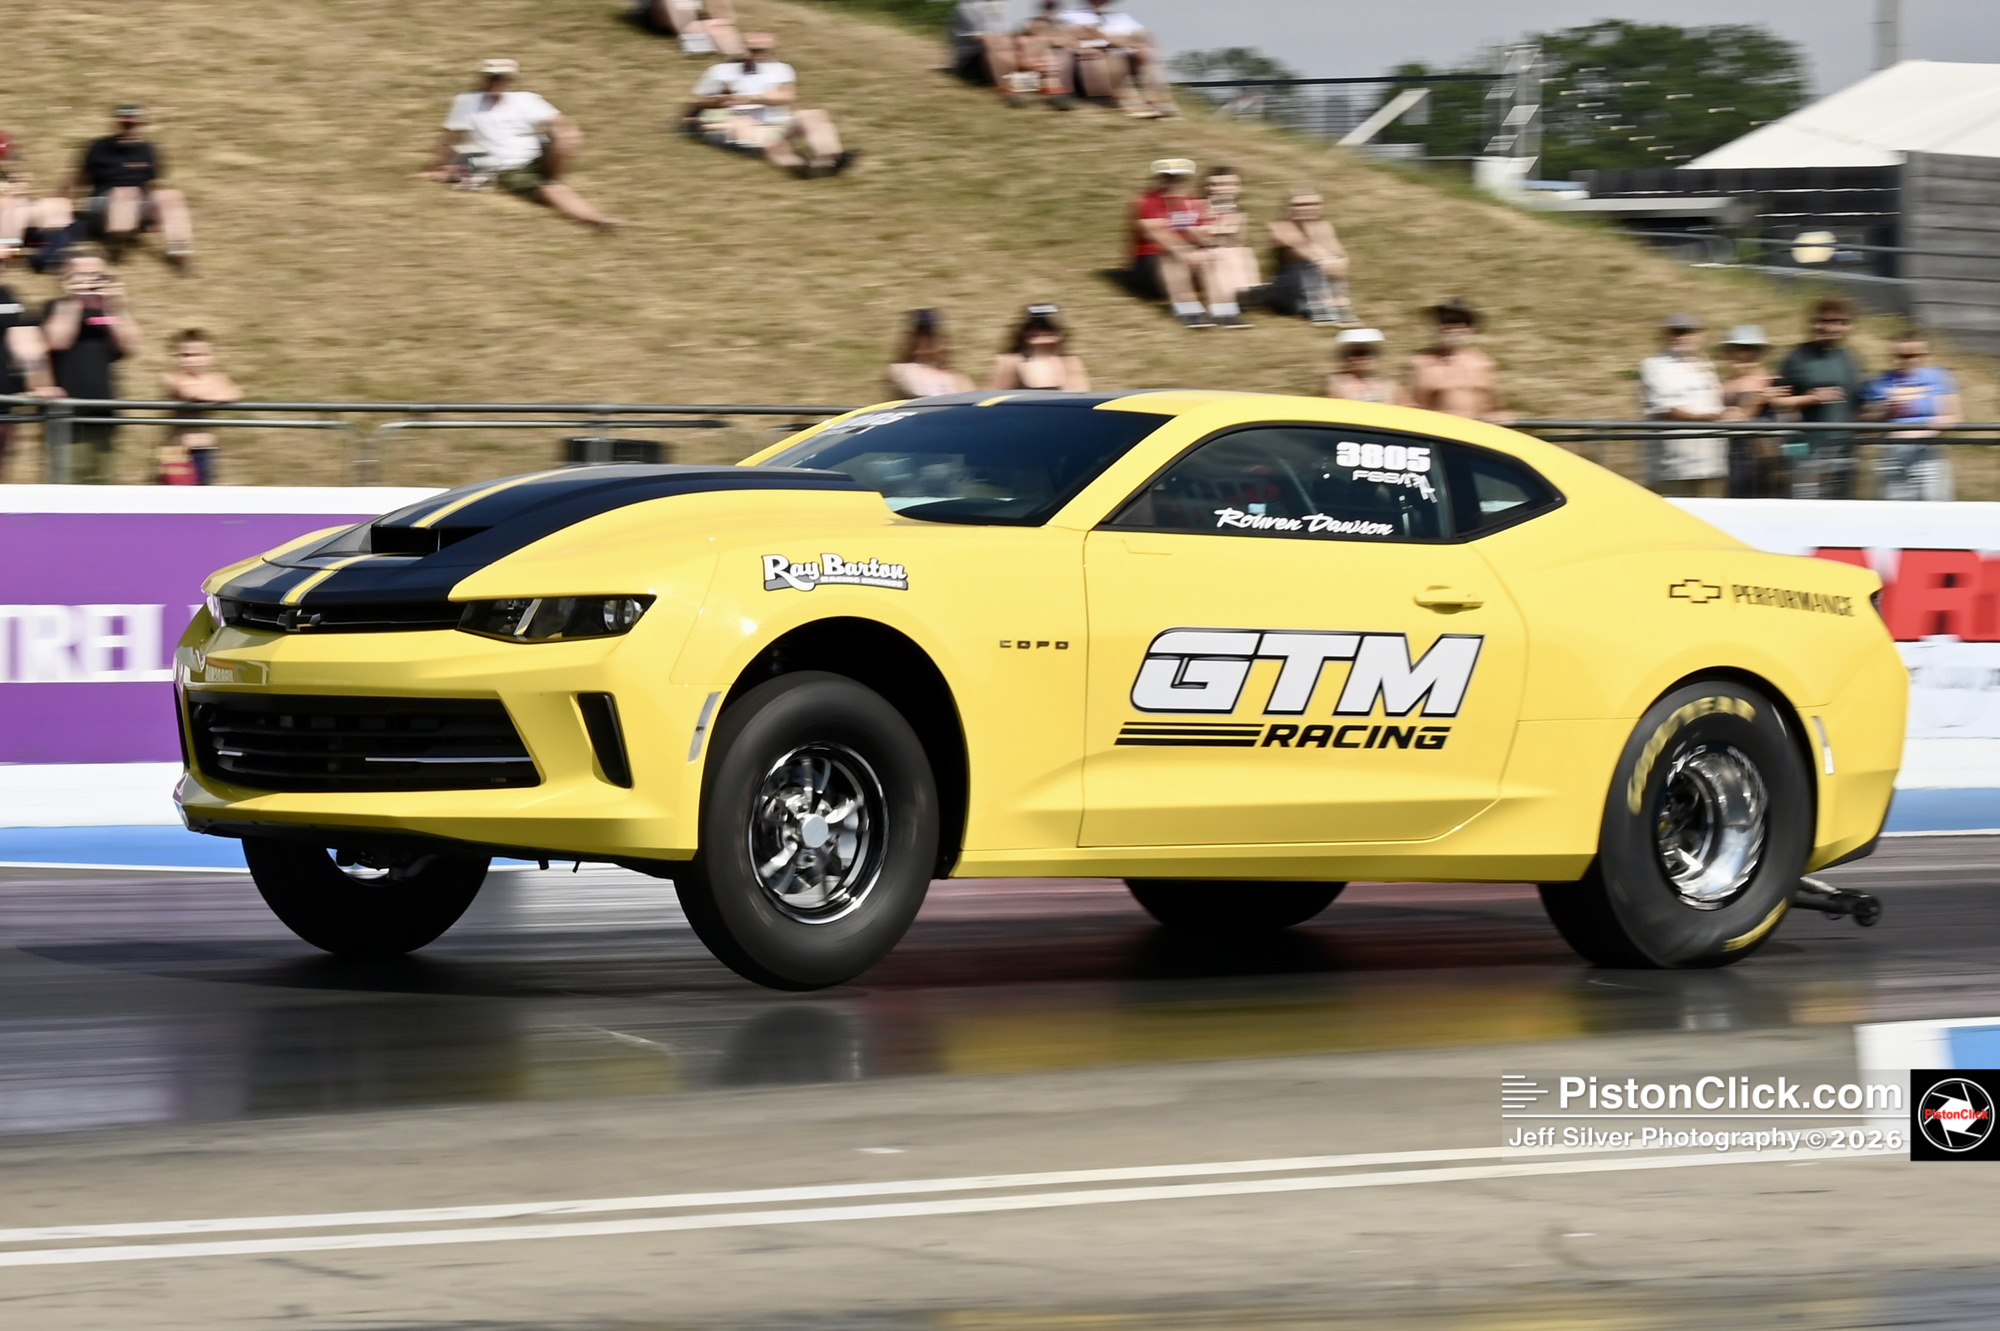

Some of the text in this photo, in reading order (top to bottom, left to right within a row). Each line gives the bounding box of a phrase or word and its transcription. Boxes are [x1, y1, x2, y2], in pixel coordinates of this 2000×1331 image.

[1336, 441, 1431, 473] 3805
[1214, 507, 1394, 536] Rouven Dawson
[761, 553, 908, 592] Ray Barton
[1732, 584, 1855, 617] PERFORMANCE
[999, 640, 1069, 650] COPO
[1130, 627, 1485, 718] GTM
[1260, 724, 1453, 750] RACING
